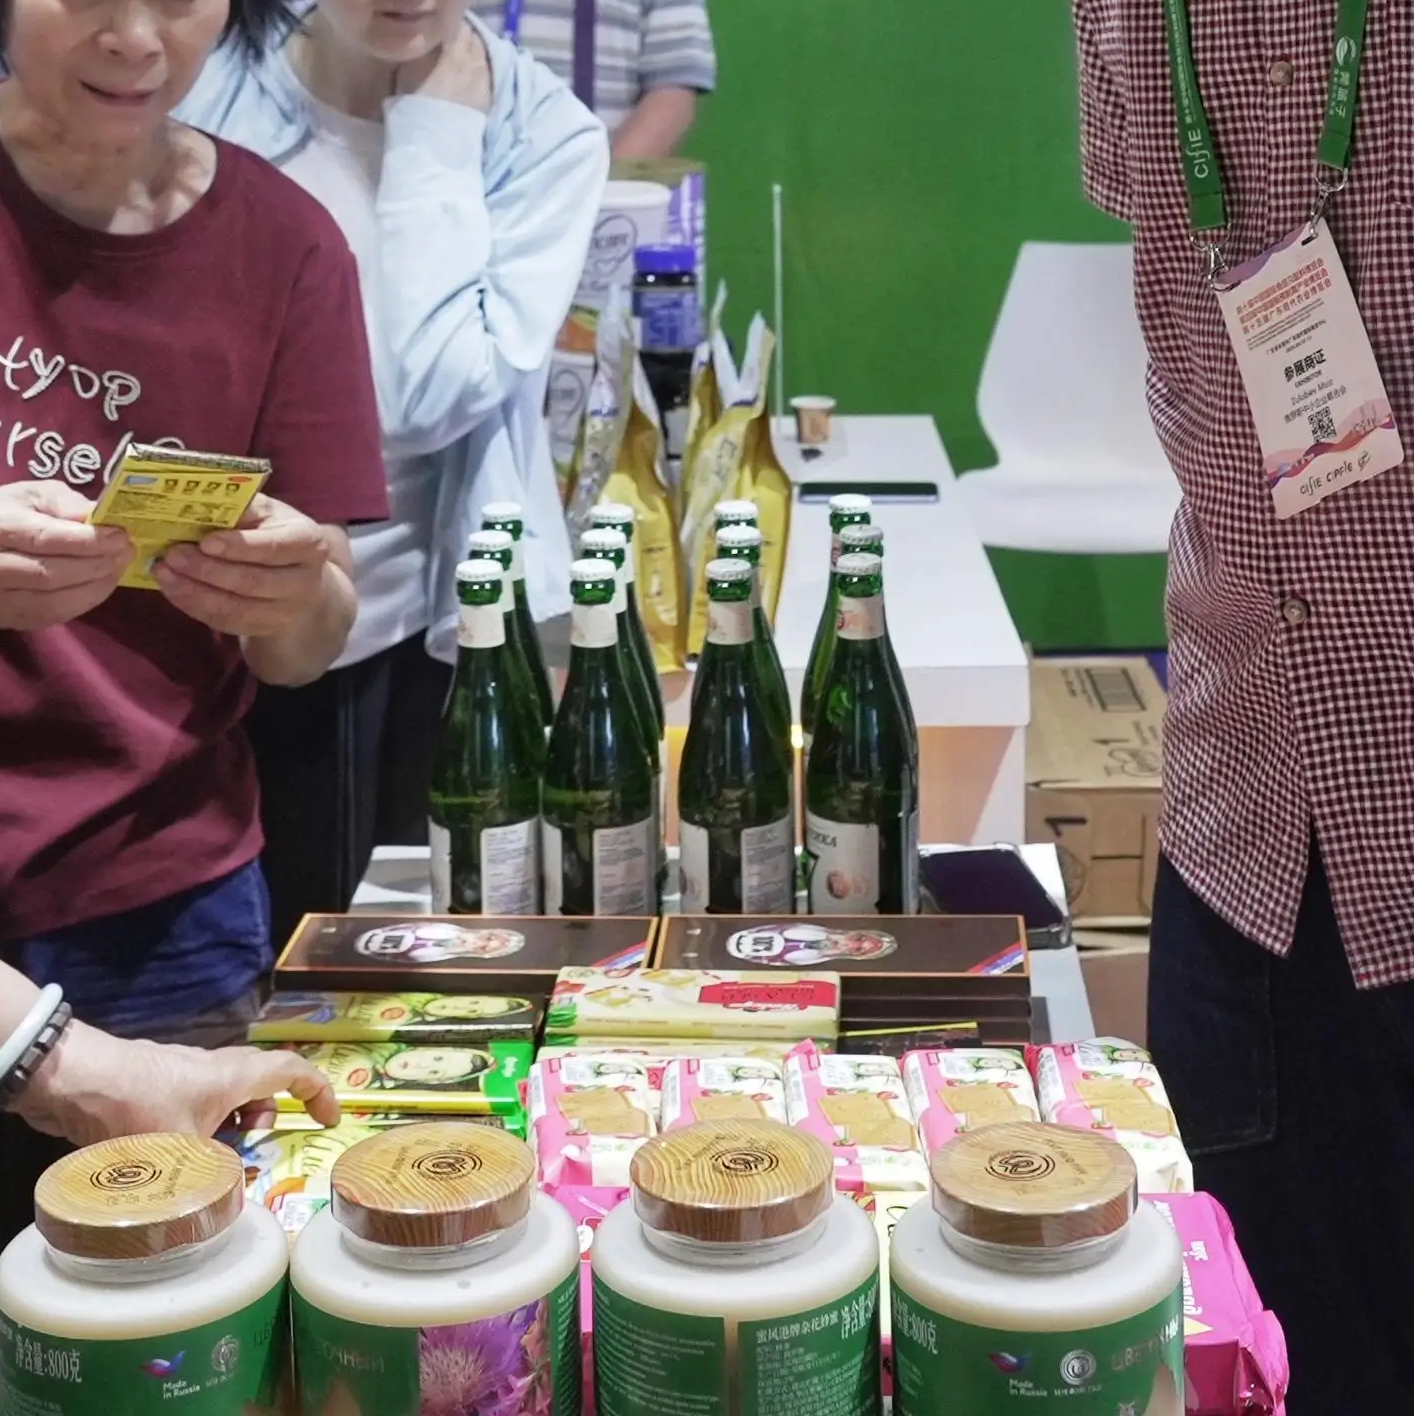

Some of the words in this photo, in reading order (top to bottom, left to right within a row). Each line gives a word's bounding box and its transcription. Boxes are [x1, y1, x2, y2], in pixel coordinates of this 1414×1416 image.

[1284, 349, 1327, 382] 参展商证
[163, 1379, 187, 1391] Made
[1009, 1378, 1034, 1389] Made
[173, 1385, 200, 1398] Russia
[1019, 1387, 1048, 1397] Russia
